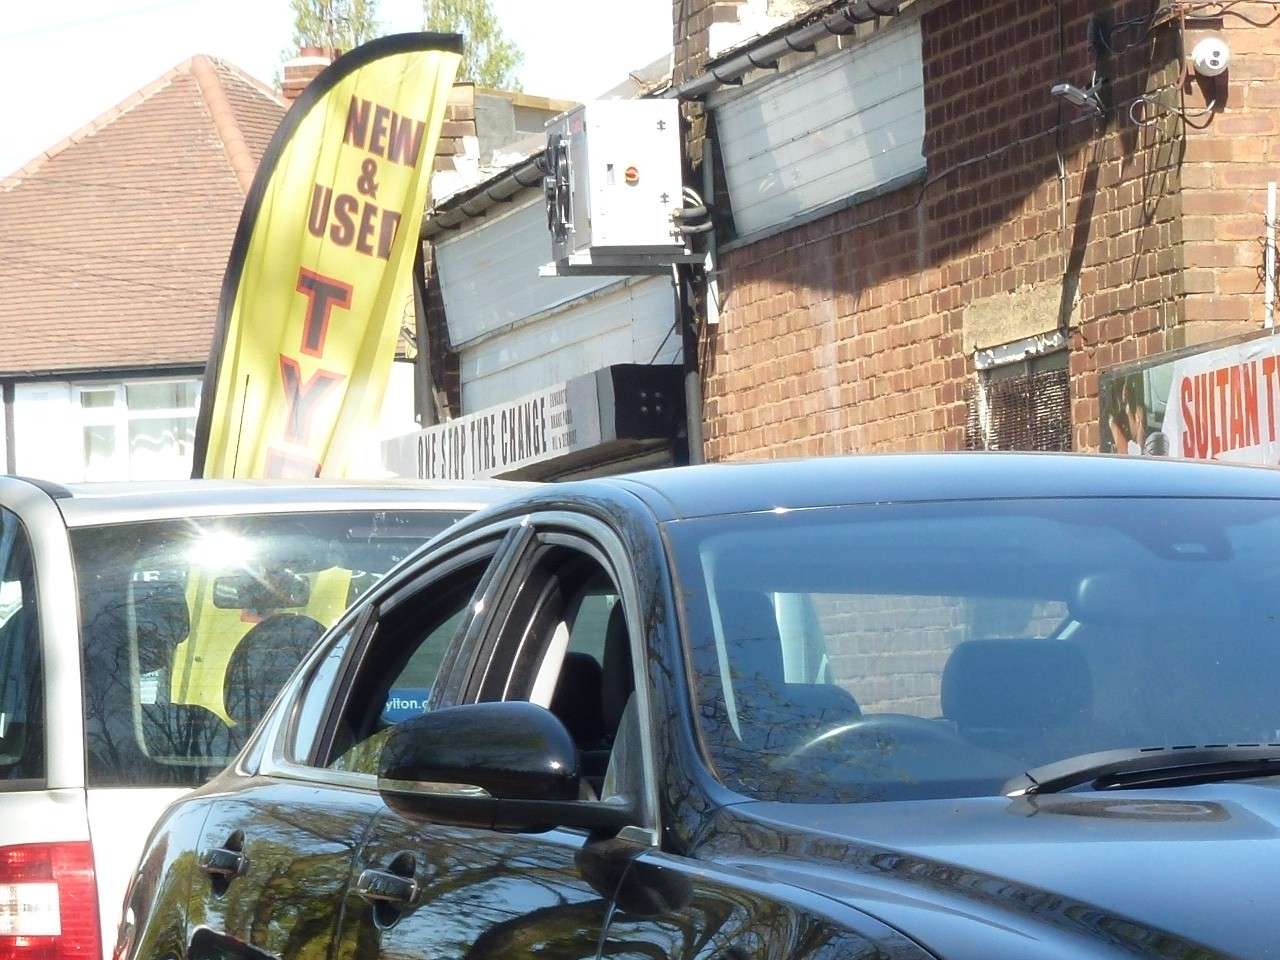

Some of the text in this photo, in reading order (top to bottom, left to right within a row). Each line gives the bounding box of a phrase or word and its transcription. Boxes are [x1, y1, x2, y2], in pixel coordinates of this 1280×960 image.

[343, 94, 426, 168] NEW
[356, 157, 379, 199] &
[307, 183, 402, 262] USED
[417, 396, 547, 479] ONE STOP TYRE CHANGE
[1180, 360, 1260, 459] SULTAN
